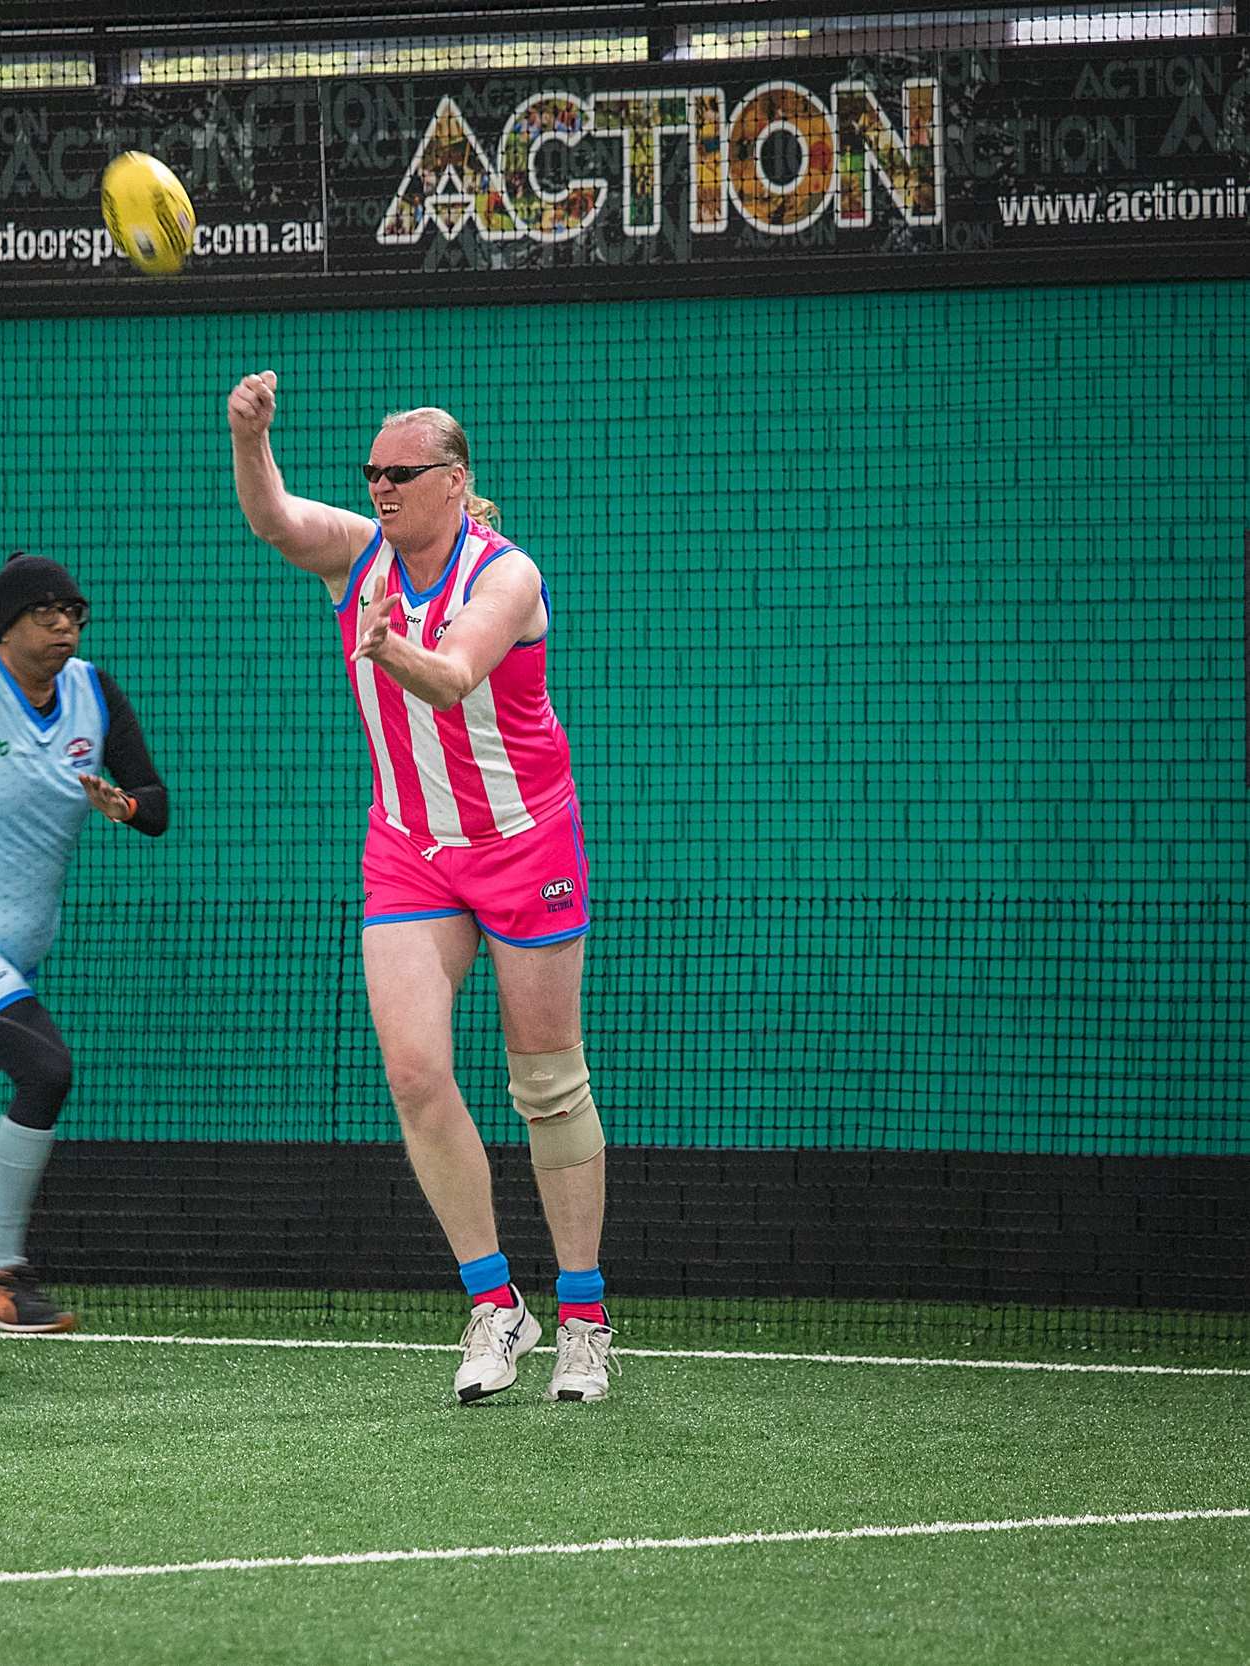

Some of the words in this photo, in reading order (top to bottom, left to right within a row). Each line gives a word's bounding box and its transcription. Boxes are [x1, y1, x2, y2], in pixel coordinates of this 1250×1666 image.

[1072, 55, 1222, 100] ACTION
[376, 77, 942, 245] ACTION
[545, 880, 573, 898] AFL
